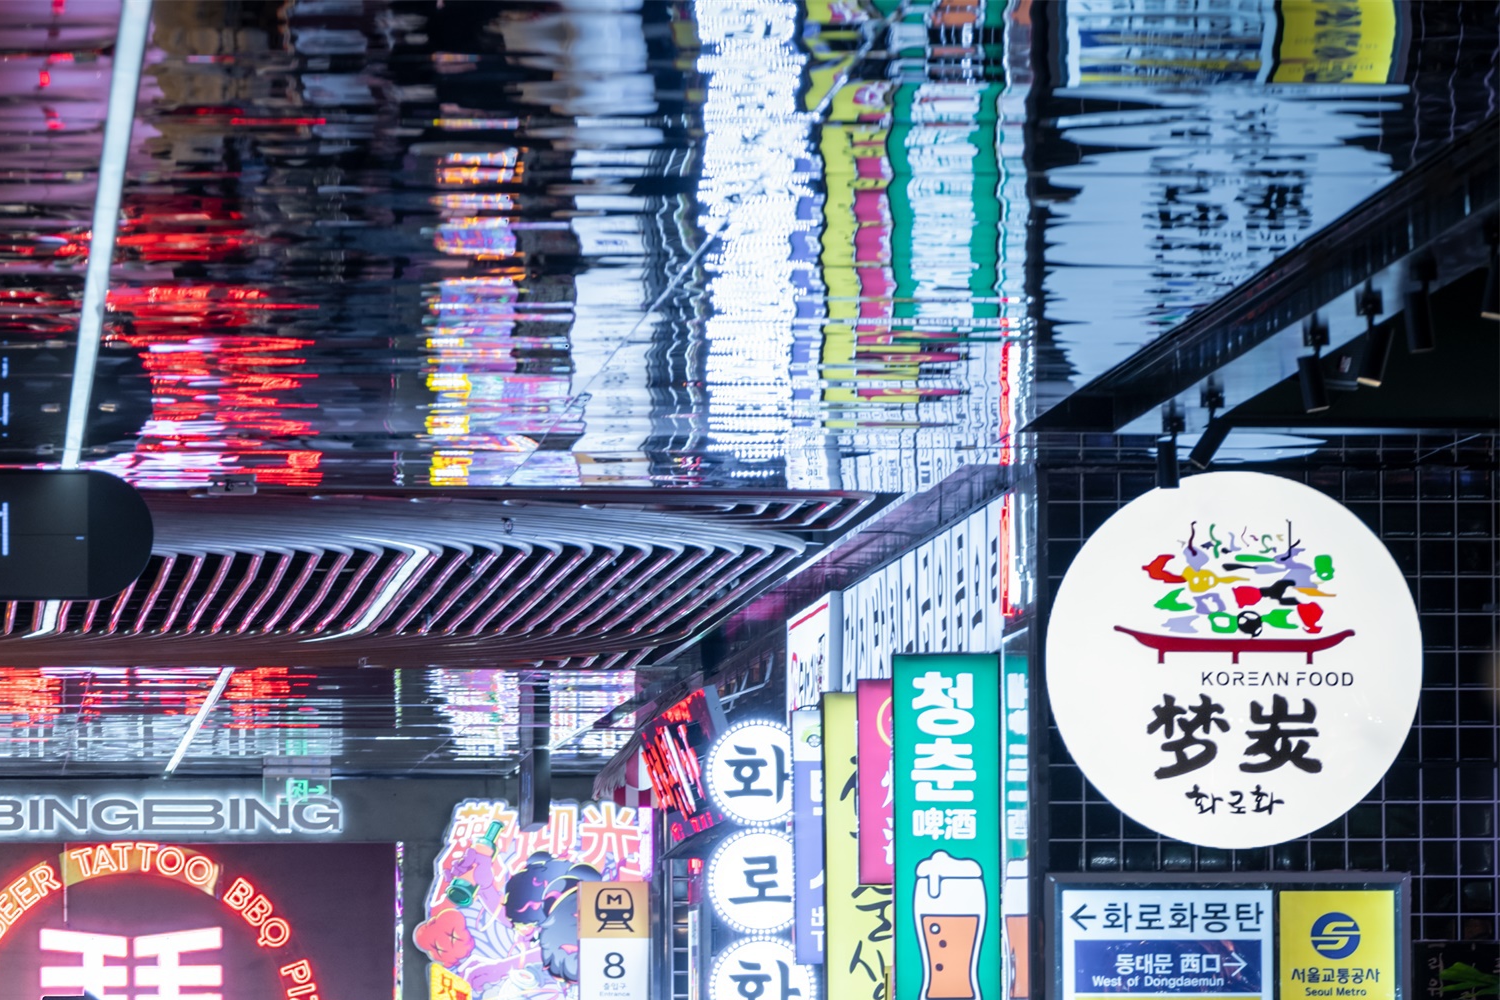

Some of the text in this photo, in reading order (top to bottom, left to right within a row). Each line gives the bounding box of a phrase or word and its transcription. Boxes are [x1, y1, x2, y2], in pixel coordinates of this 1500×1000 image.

[1202, 671, 1354, 687] KOREAN FOOD
[911, 671, 977, 802] 청춘
[1147, 693, 1322, 779] 梦炭
[1185, 784, 1285, 815] 화로화
[913, 808, 977, 841] 啤酒
[71, 842, 214, 886] TATTOO
[223, 877, 290, 947] BBQ
[1102, 902, 1264, 933] 화로화몽탄
[603, 952, 626, 979] 8
[1115, 954, 1221, 975] 동대문 西口
[1291, 967, 1380, 985] 서울교통공사
[1092, 975, 1225, 989] West of Dongdaemun
[1305, 987, 1367, 997] Seoul Metro
